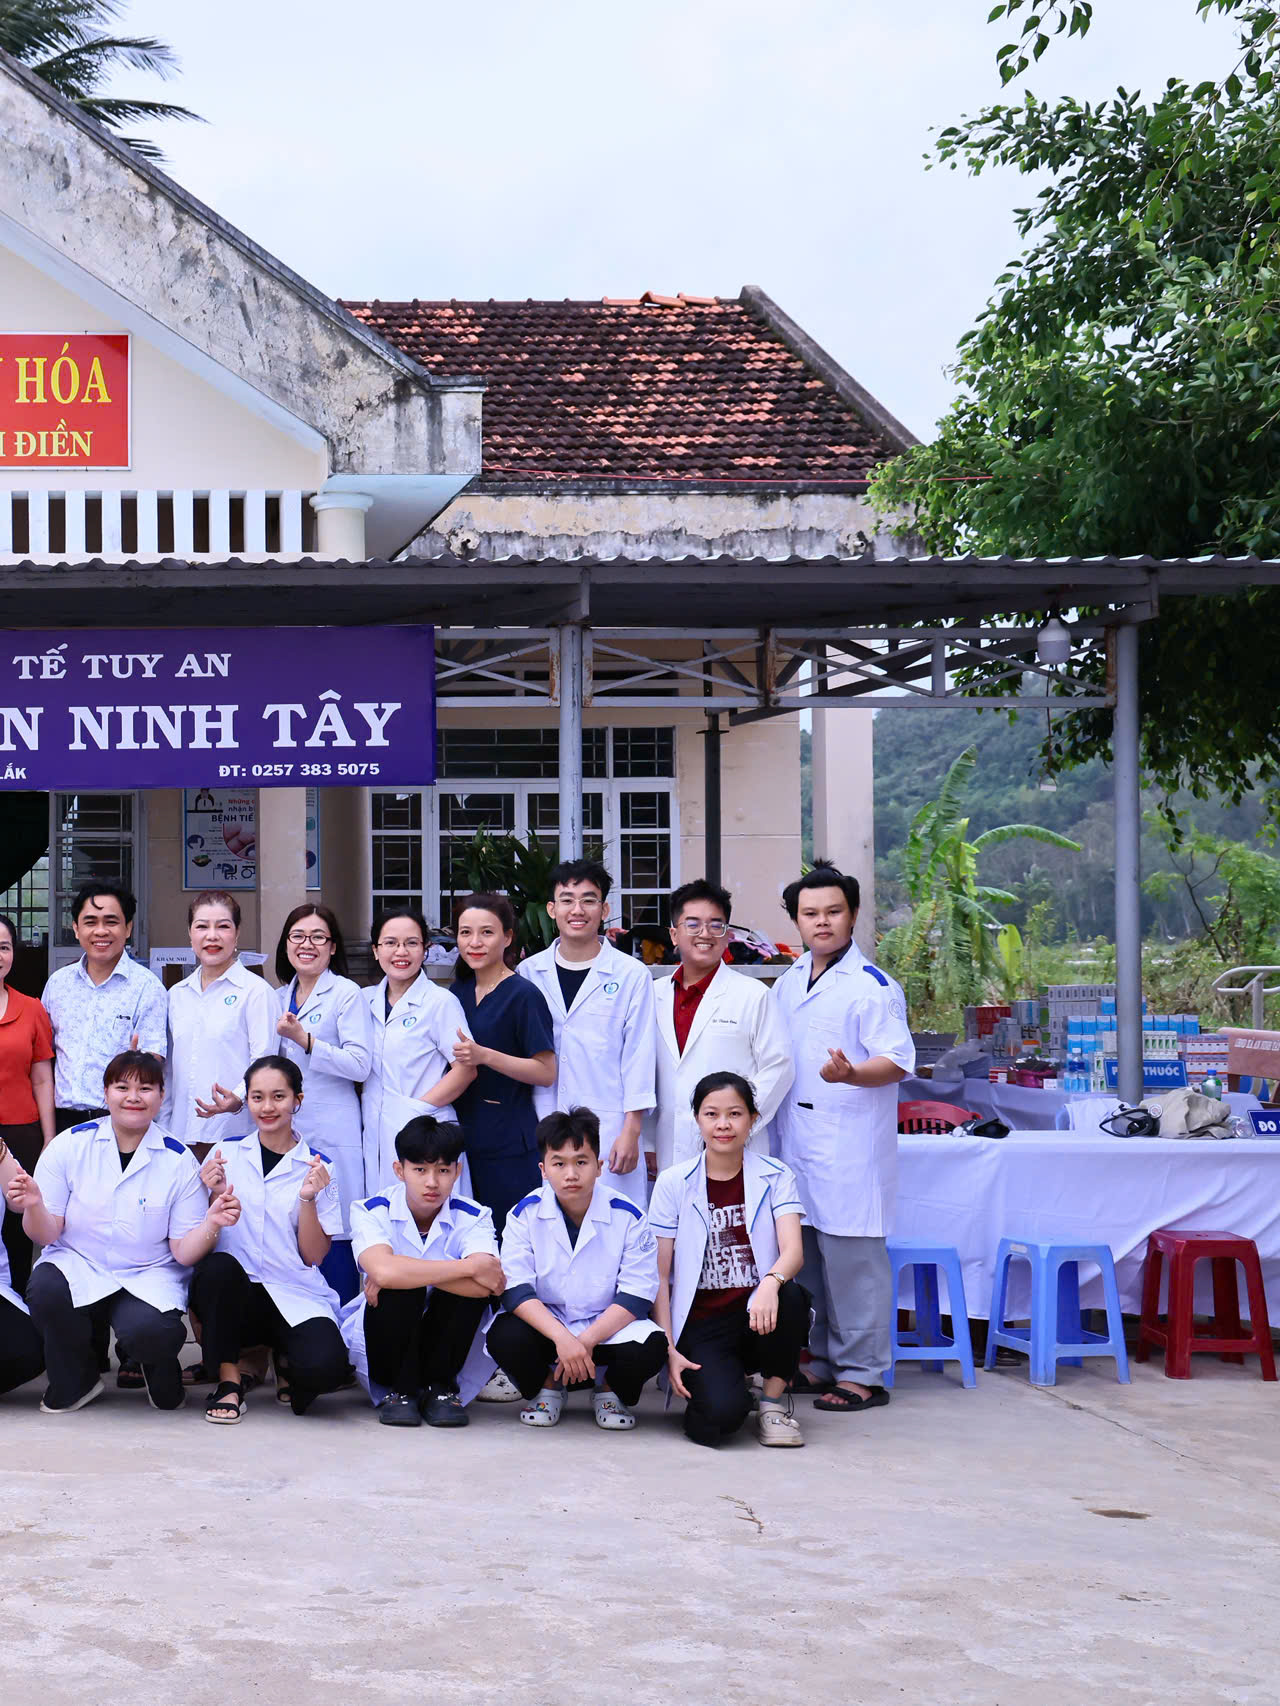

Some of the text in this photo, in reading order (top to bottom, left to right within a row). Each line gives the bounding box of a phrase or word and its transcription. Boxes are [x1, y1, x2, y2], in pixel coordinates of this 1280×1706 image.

[15, 341, 113, 404] HÓA
[14, 418, 94, 457] ĐIỀN
[13, 643, 68, 680] TẾ
[81, 654, 164, 679] TUY
[175, 653, 232, 677] AN
[68, 704, 239, 751] NINH
[262, 689, 402, 748] TÂY
[218, 763, 380, 777] ĐT: 0257 383 5075
[211, 813, 237, 824] BỆNH
[1258, 1120, 1277, 1132] ĐO
